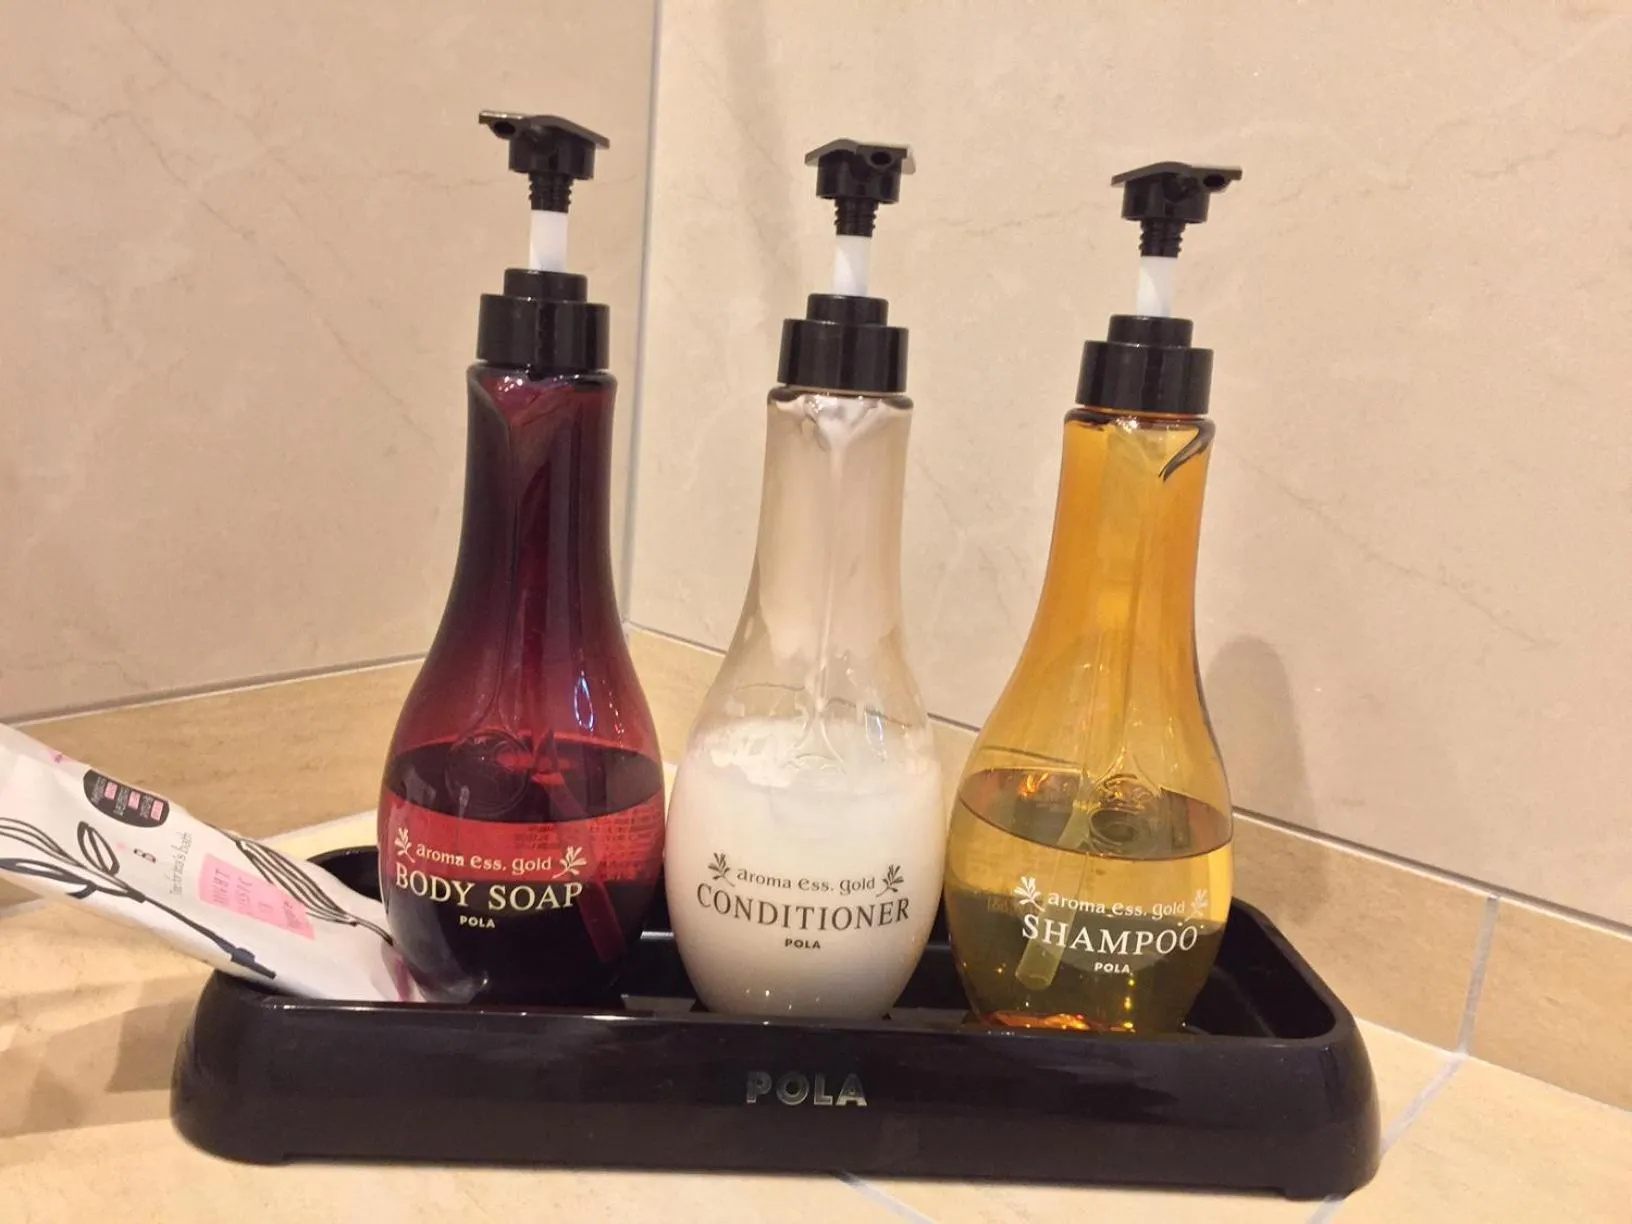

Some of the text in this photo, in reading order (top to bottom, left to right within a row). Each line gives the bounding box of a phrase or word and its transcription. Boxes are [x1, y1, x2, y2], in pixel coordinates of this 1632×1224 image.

[416, 844, 553, 876] aroma ess. gold
[395, 862, 583, 912] BODY SOAP
[737, 868, 876, 895] aroma ess. gold
[696, 882, 910, 931] CONDITIONER
[1047, 892, 1185, 920] aroma ess. gold
[459, 915, 496, 929] POLA
[1022, 913, 1199, 956] SHAMPOO
[784, 938, 821, 950] POLA
[1093, 962, 1131, 974] POLA
[746, 1071, 867, 1107] POLA
